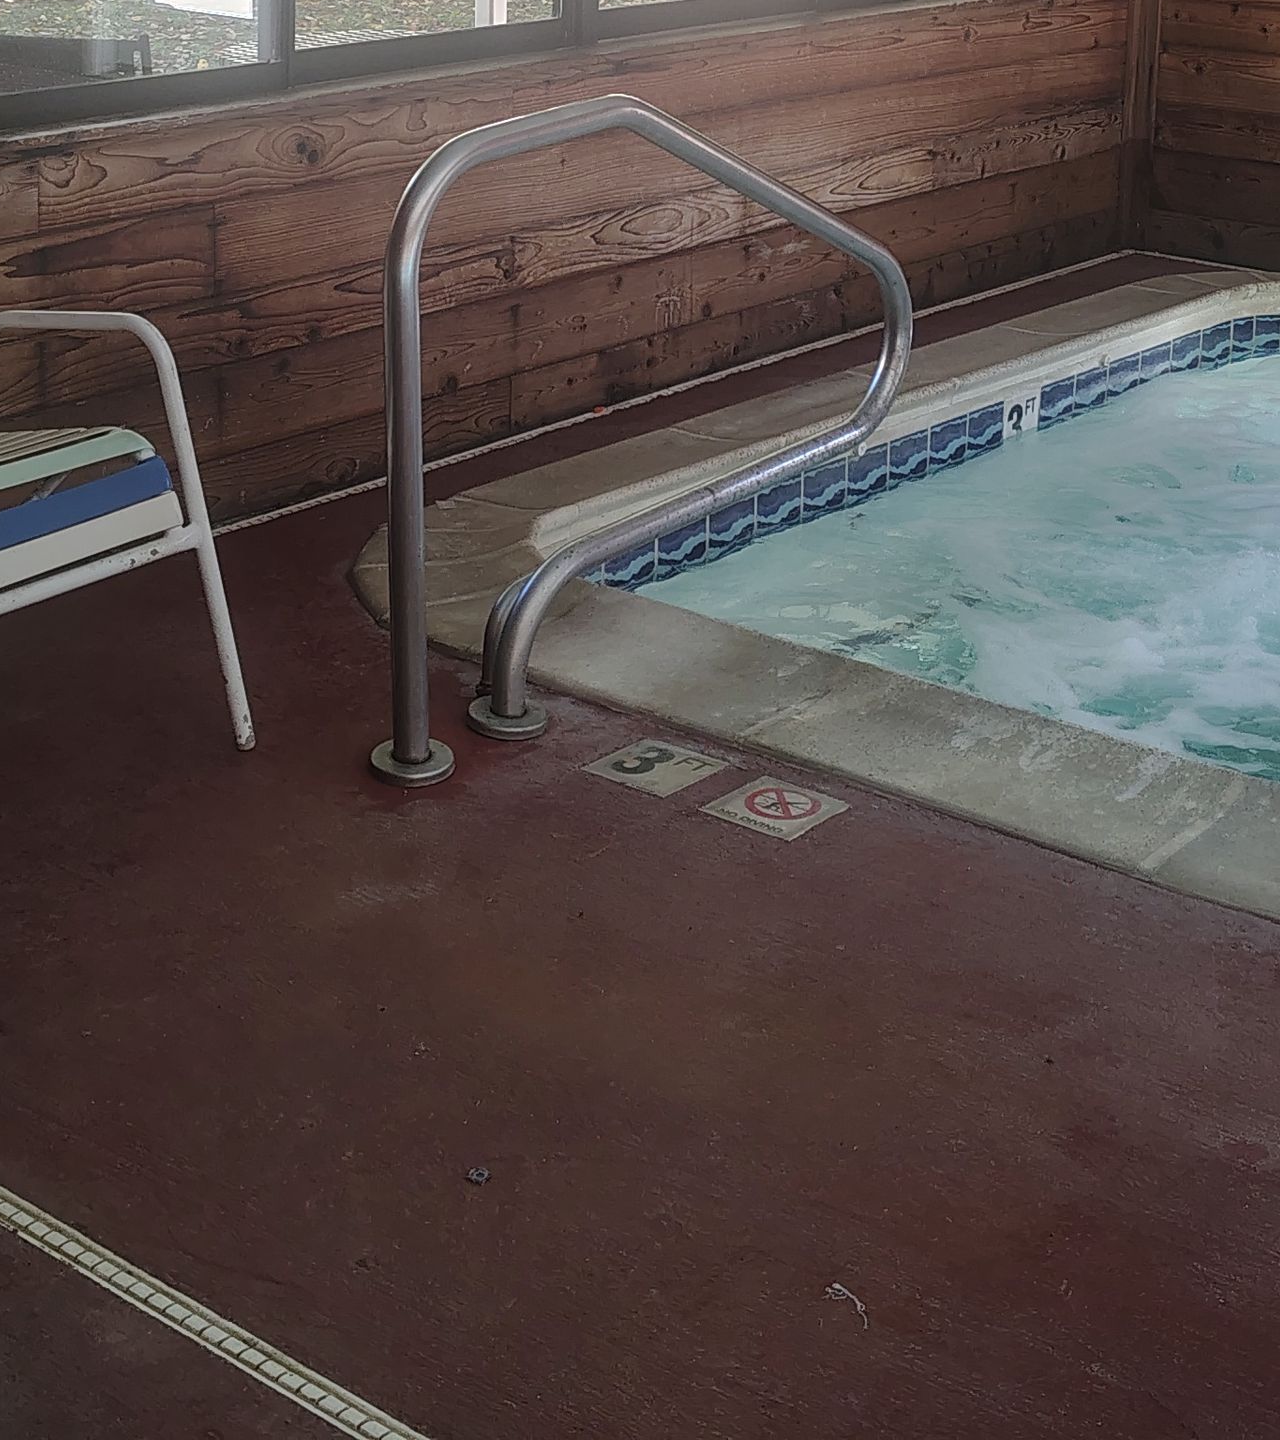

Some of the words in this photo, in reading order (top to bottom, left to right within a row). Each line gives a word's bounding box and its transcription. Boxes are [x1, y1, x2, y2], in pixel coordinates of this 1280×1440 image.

[1025, 396, 1037, 416] FT
[611, 746, 676, 775] 3
[673, 757, 715, 772] FT
[719, 808, 738, 819] NO
[738, 815, 784, 834] DIVING
